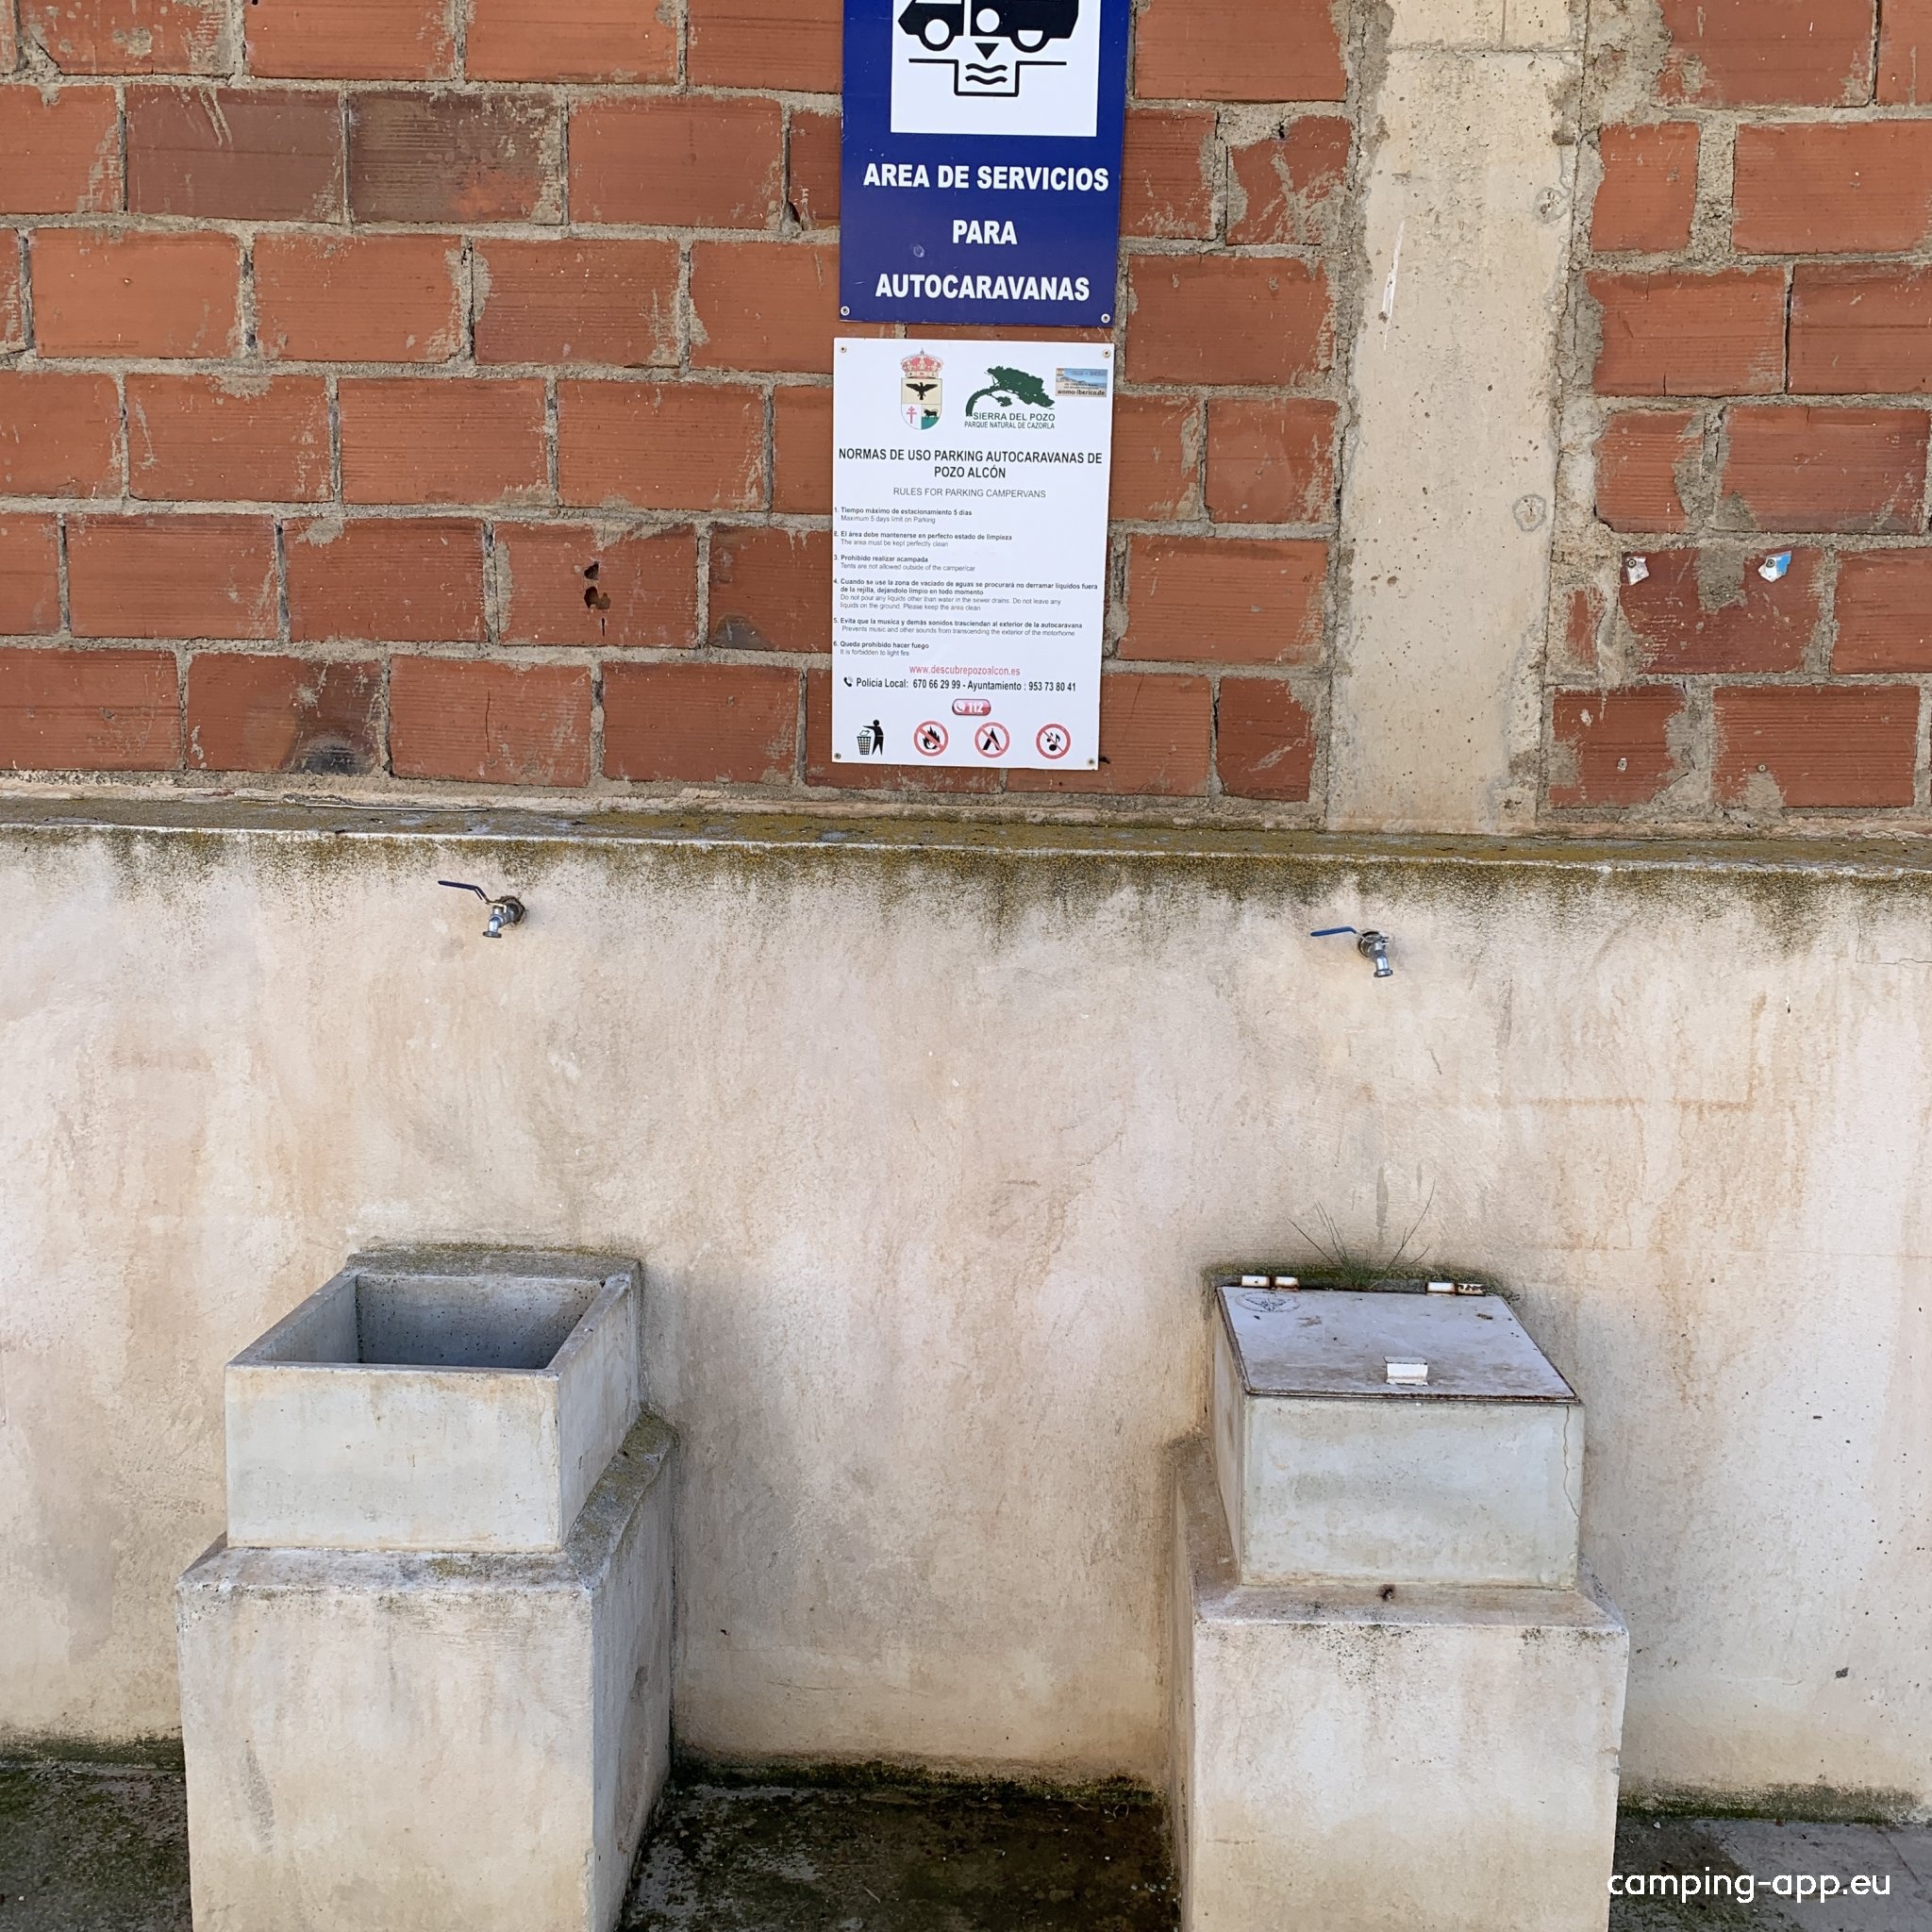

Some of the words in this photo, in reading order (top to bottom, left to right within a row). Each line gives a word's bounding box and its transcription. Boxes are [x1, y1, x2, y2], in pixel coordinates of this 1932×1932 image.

[863, 163, 930, 188] AREA
[938, 165, 970, 189] DE
[976, 166, 1109, 192] SERVICIOS
[952, 219, 1018, 245] PARA
[875, 274, 1090, 301] AUTOCARAVANAS
[973, 411, 1007, 420] SIERRA
[1009, 412, 1028, 421] DEL
[1030, 412, 1055, 421] POZO
[964, 421, 988, 429] PARQUE
[839, 448, 886, 460] NORMAS
[890, 449, 904, 460] DE
[908, 450, 931, 461] USO
[934, 450, 983, 462] PARKING
[986, 451, 1084, 463] AUTOCARAVANAS
[1088, 452, 1102, 464] DE
[934, 465, 965, 478] POZO
[968, 466, 1006, 479] ALCÓN
[893, 487, 922, 496] RULES
[924, 488, 943, 497] FOR
[945, 488, 984, 497] PARKING
[986, 488, 1046, 498] CAMPERVANS
[841, 506, 864, 515] Tiempo
[876, 515, 890, 523] days
[913, 516, 936, 524] Parking
[928, 532, 953, 540] perfecto
[986, 533, 1012, 541] limpieza
[907, 539, 931, 548] perfectly
[897, 555, 928, 564] acampada
[956, 580, 974, 588] aguas
[984, 581, 1015, 589] procurará
[909, 587, 928, 595] limpio
[861, 594, 874, 602] pour
[888, 595, 906, 603] liquids
[840, 601, 859, 609] liquids
[924, 603, 939, 611] keep
[857, 617, 869, 625] que
[840, 640, 860, 649] Queda
[862, 641, 891, 649] prohibido
[911, 642, 929, 650] fuego
[887, 649, 899, 657] light
[909, 665, 1021, 677] www.descubrepozoalcon.es
[856, 678, 883, 687] Policía
[885, 679, 908, 688] Local:
[913, 679, 927, 688] 670
[929, 680, 938, 688] 66
[940, 680, 949, 689] 29
[952, 680, 961, 689] 99
[968, 680, 1022, 691] Ayuntamiento
[1029, 682, 1042, 690] 953
[1045, 682, 1054, 691] 73
[1056, 682, 1065, 691] 80
[1067, 682, 1076, 691] 41
[968, 702, 983, 713] 112
